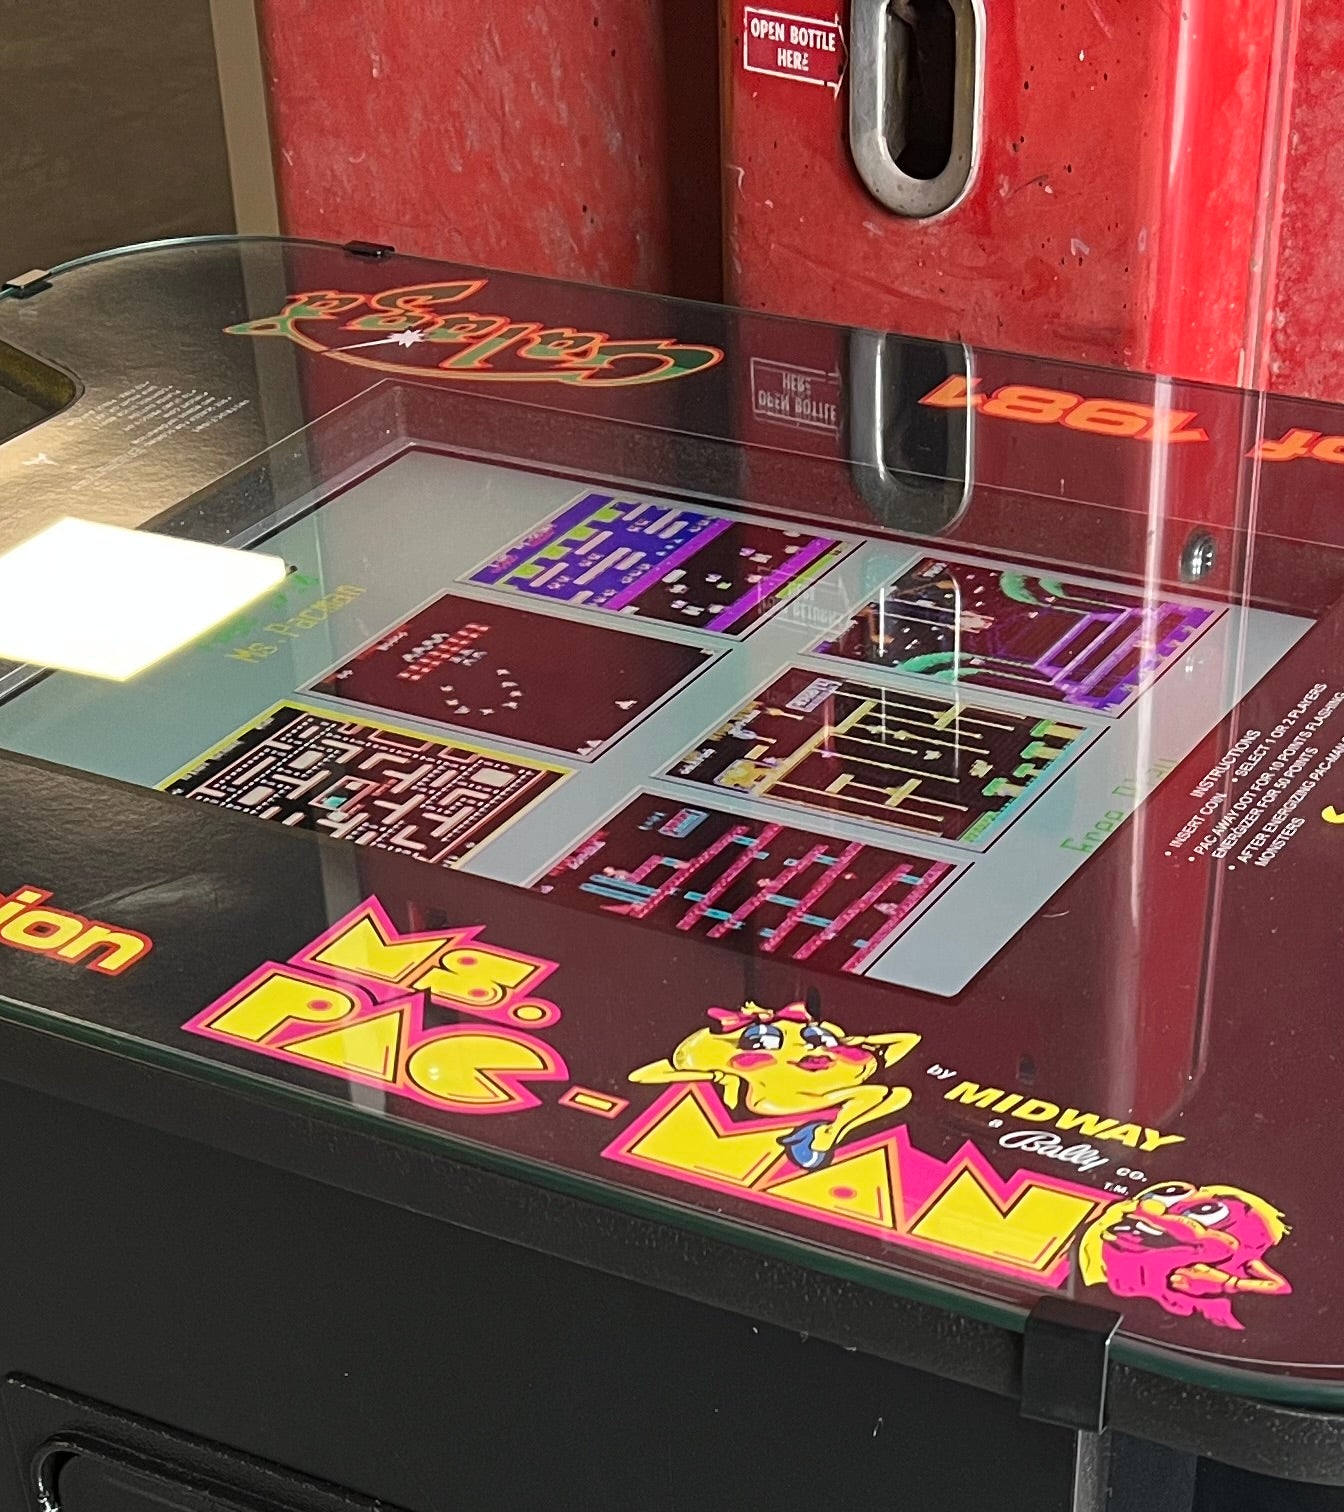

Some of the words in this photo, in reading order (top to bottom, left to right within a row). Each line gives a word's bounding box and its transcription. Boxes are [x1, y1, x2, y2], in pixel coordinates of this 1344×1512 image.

[750, 18, 785, 42] OPEN
[790, 25, 836, 52] BOTTLE
[777, 47, 809, 71] HERE
[917, 374, 1210, 443] 1981
[1282, 718, 1295, 726] 2
[1288, 683, 1328, 720] PLAYERS
[1271, 724, 1289, 738] OR
[1190, 729, 1261, 798] INSTRUCTIONS
[1235, 744, 1271, 777] SELECT
[1169, 814, 1205, 848] INSERT
[1199, 792, 1228, 815] COIN
[1193, 835, 1217, 855] PAC
[1212, 809, 1240, 837] AWAY
[1233, 790, 1257, 811] DOT
[1251, 772, 1275, 792] FOR
[1269, 759, 1285, 772] 10
[1278, 730, 1313, 763] POINTS
[1211, 807, 1265, 860] ENERGIZER
[1257, 788, 1282, 808] FOR
[1273, 777, 1291, 790] 50
[1284, 746, 1319, 778] POINTS
[1237, 832, 1271, 864] AFTER
[1262, 780, 1316, 833] ENERGIZING
[1255, 817, 1305, 867] MONSTERS
[287, 893, 562, 1028] MS.
[926, 1063, 958, 1080] by
[944, 1081, 1186, 1152] MIDWAY
[988, 1118, 1003, 1128] a
[999, 1130, 1109, 1172] Bally
